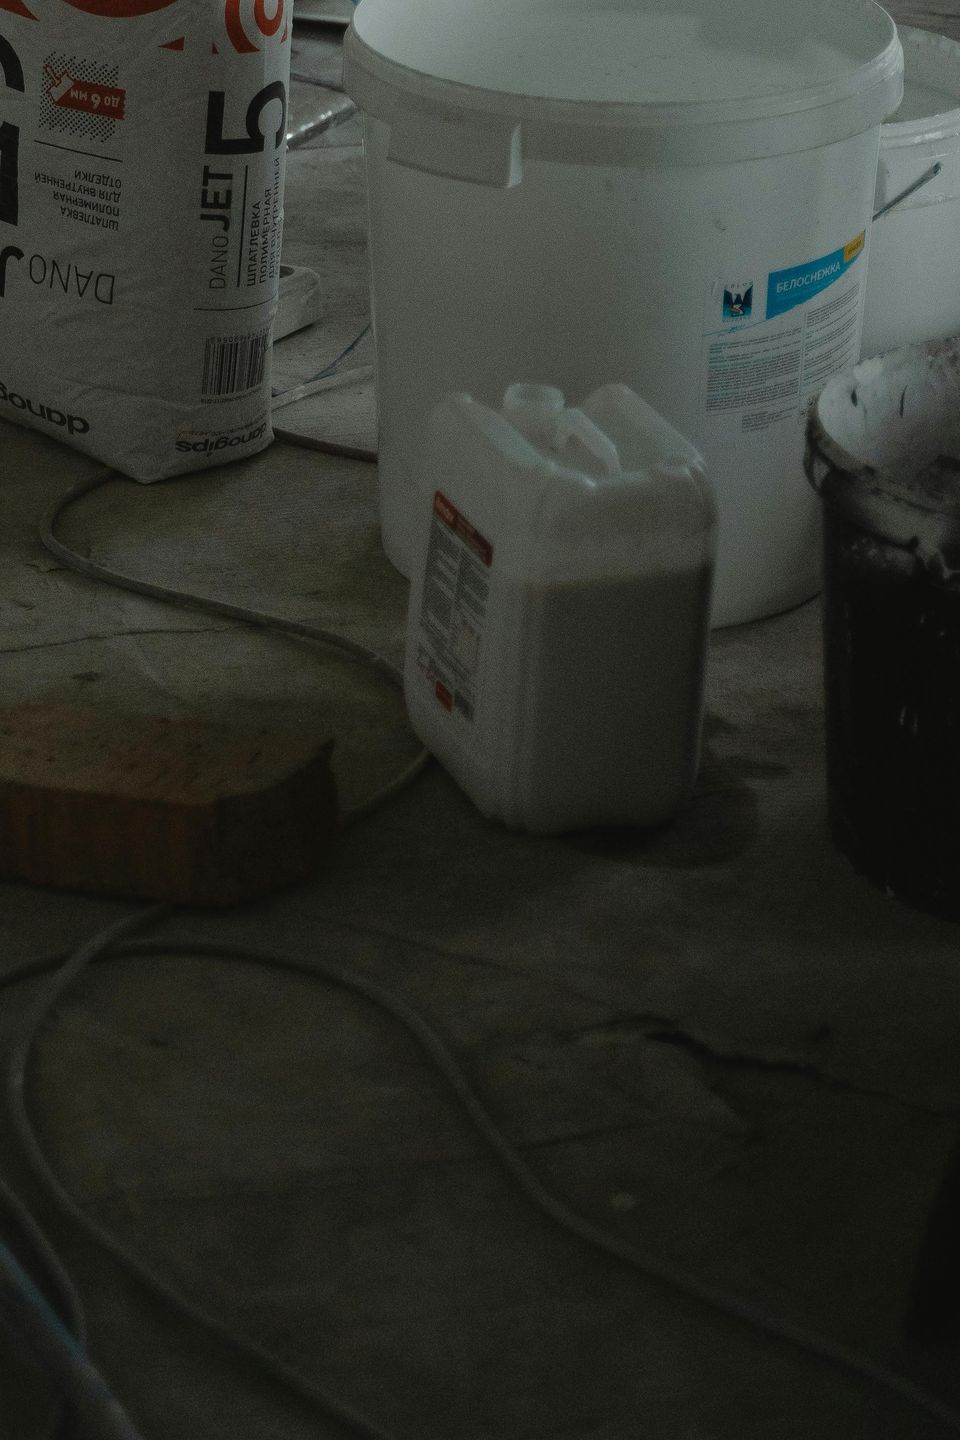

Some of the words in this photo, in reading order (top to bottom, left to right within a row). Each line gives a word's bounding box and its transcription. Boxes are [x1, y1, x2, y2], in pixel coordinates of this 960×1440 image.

[90, 91, 101, 109] 6
[205, 81, 286, 155] 5
[34, 172, 96, 197] ВНУТРЕННЕЙ
[74, 170, 122, 188] ОТДЕЛКИ
[53, 191, 120, 216] ПОЛИМЕРНАЯ
[99, 190, 121, 203] ДЛЯ
[60, 206, 119, 231] ШПАТЛЕВКА
[247, 200, 261, 287] ШПАТЛЕВКА
[259, 188, 272, 283] ПОЛИМЕРНАЯ
[775, 261, 841, 293] БЕЛОСНЕЖКА
[175, 422, 267, 457] danogips
